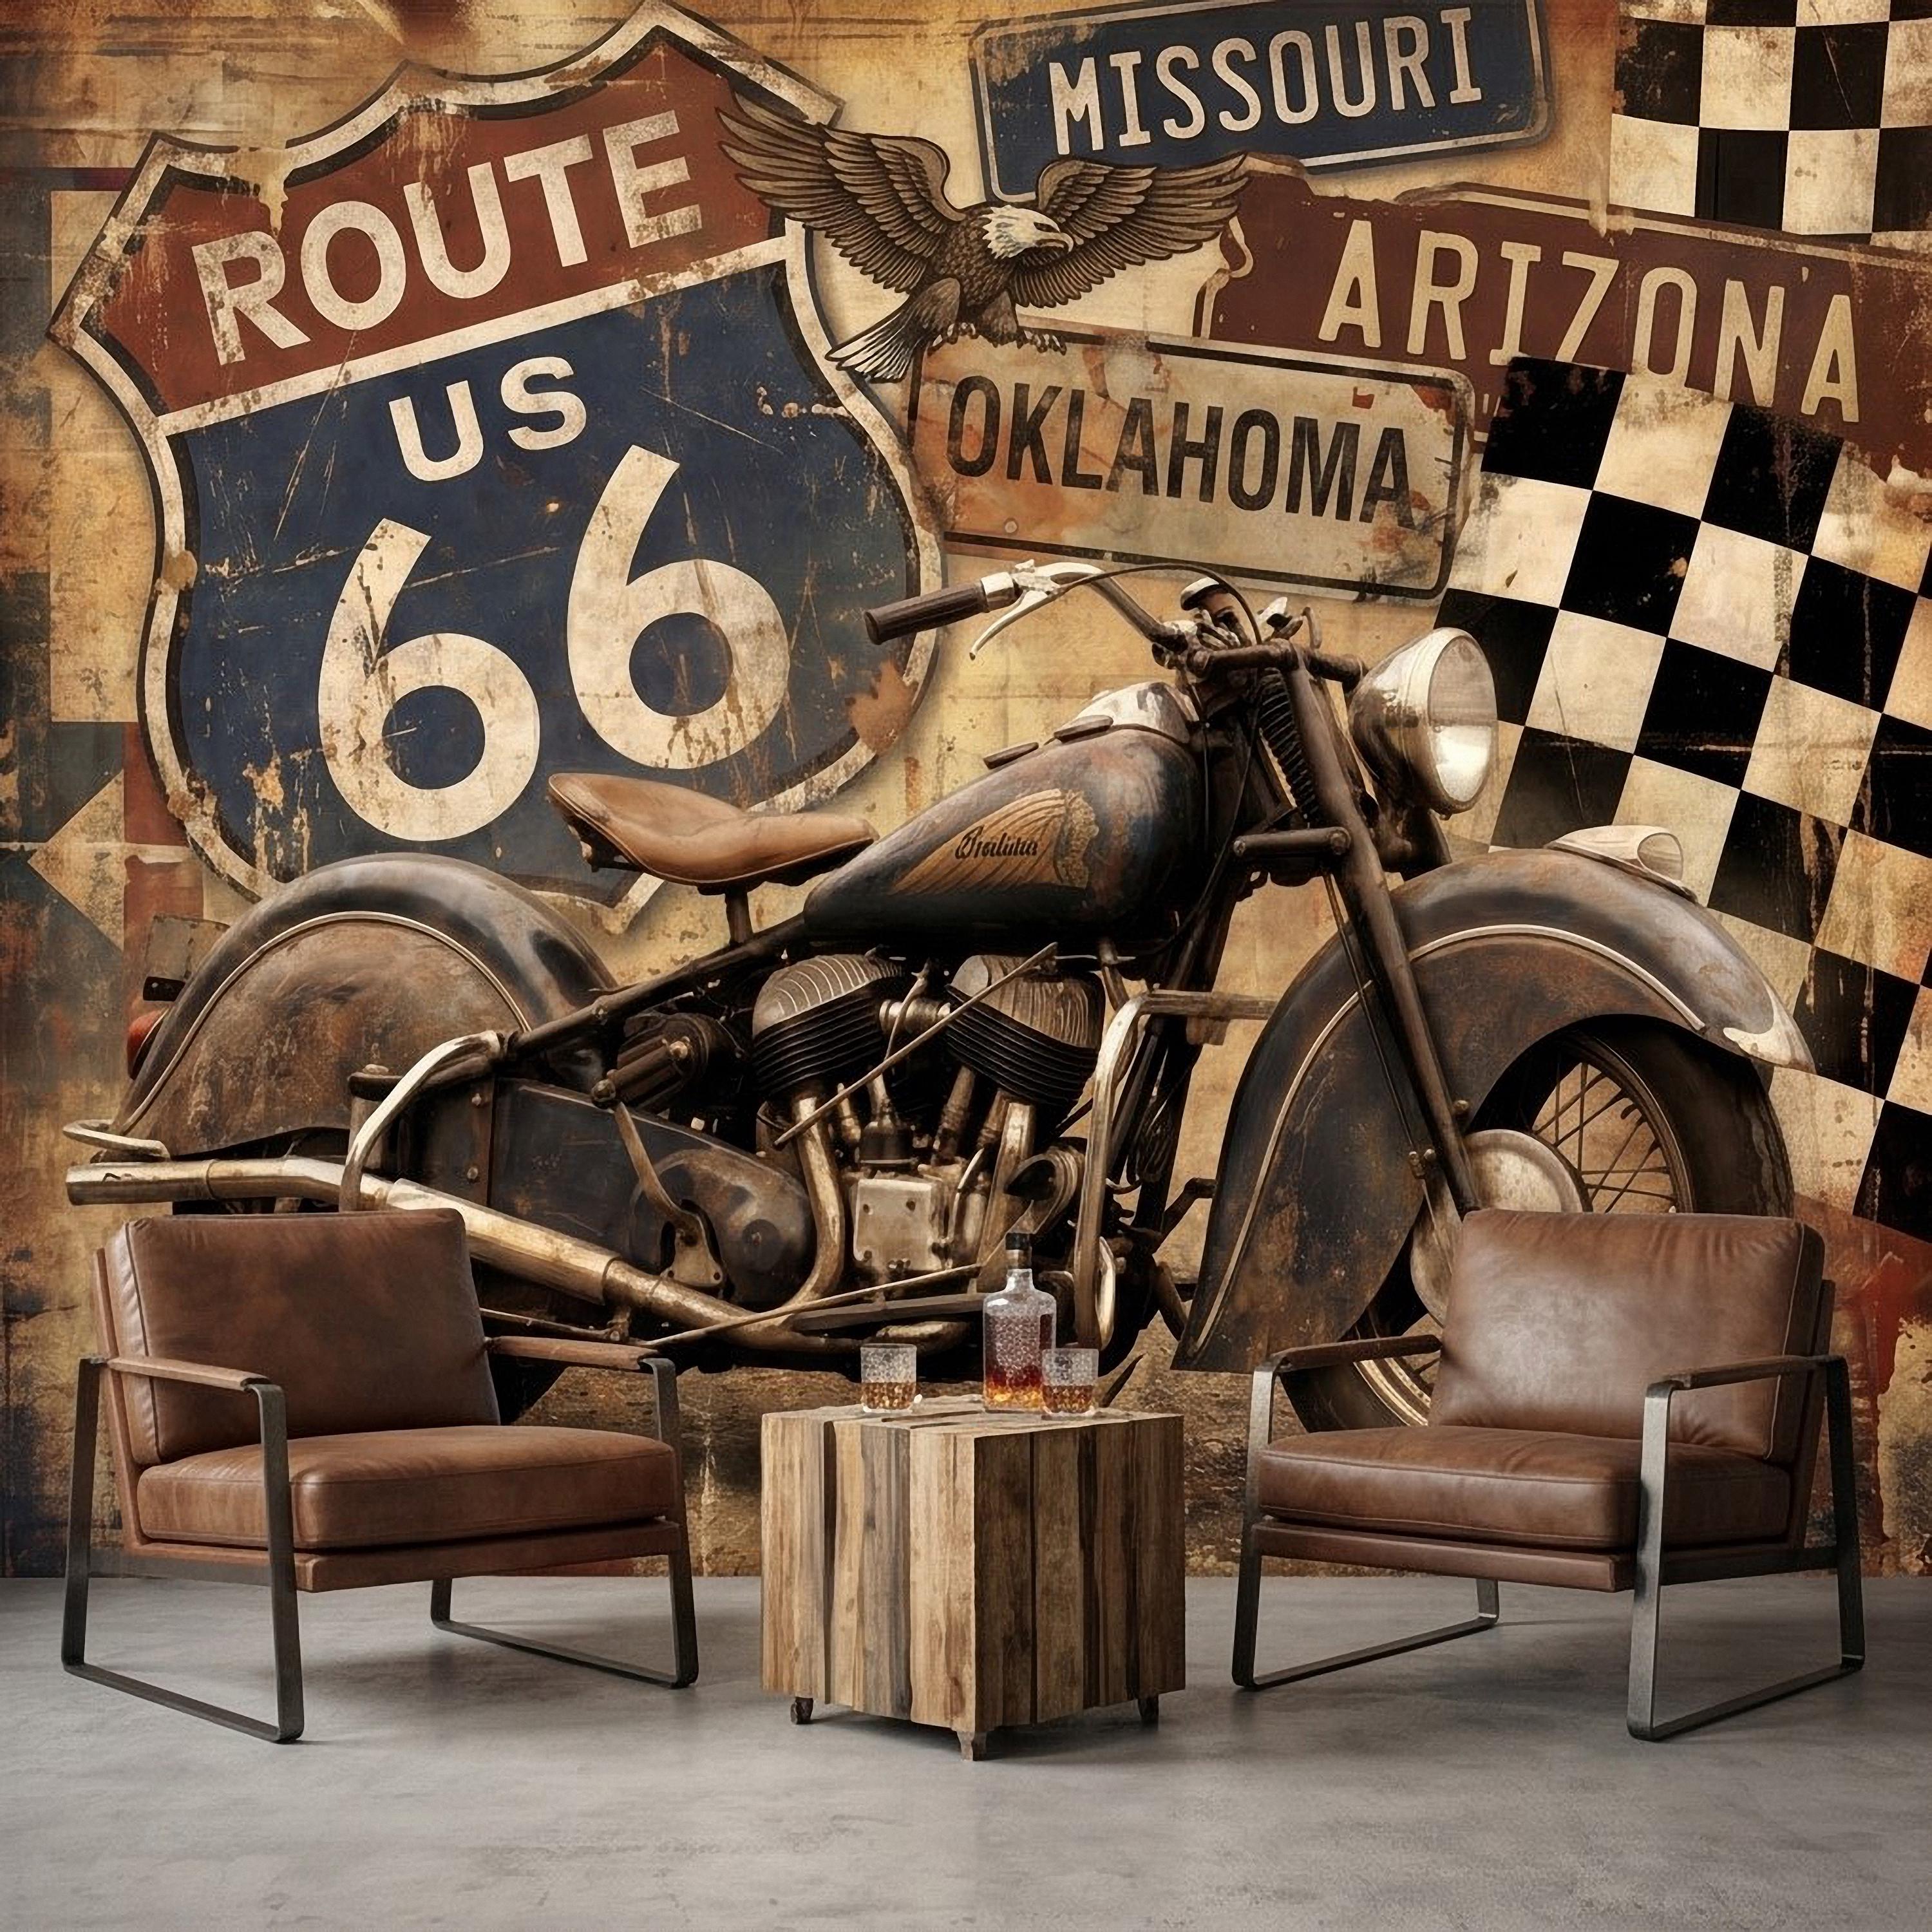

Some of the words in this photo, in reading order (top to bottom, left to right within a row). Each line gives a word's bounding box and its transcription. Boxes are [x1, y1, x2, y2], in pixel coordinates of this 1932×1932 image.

[1048, 8, 1482, 156] MISSOURI
[191, 110, 703, 365] ROUTE
[1318, 219, 1860, 423] ARIZONA
[388, 356, 587, 482] US
[947, 375, 1414, 529] OKLAHOMA
[317, 445, 789, 842] 66
